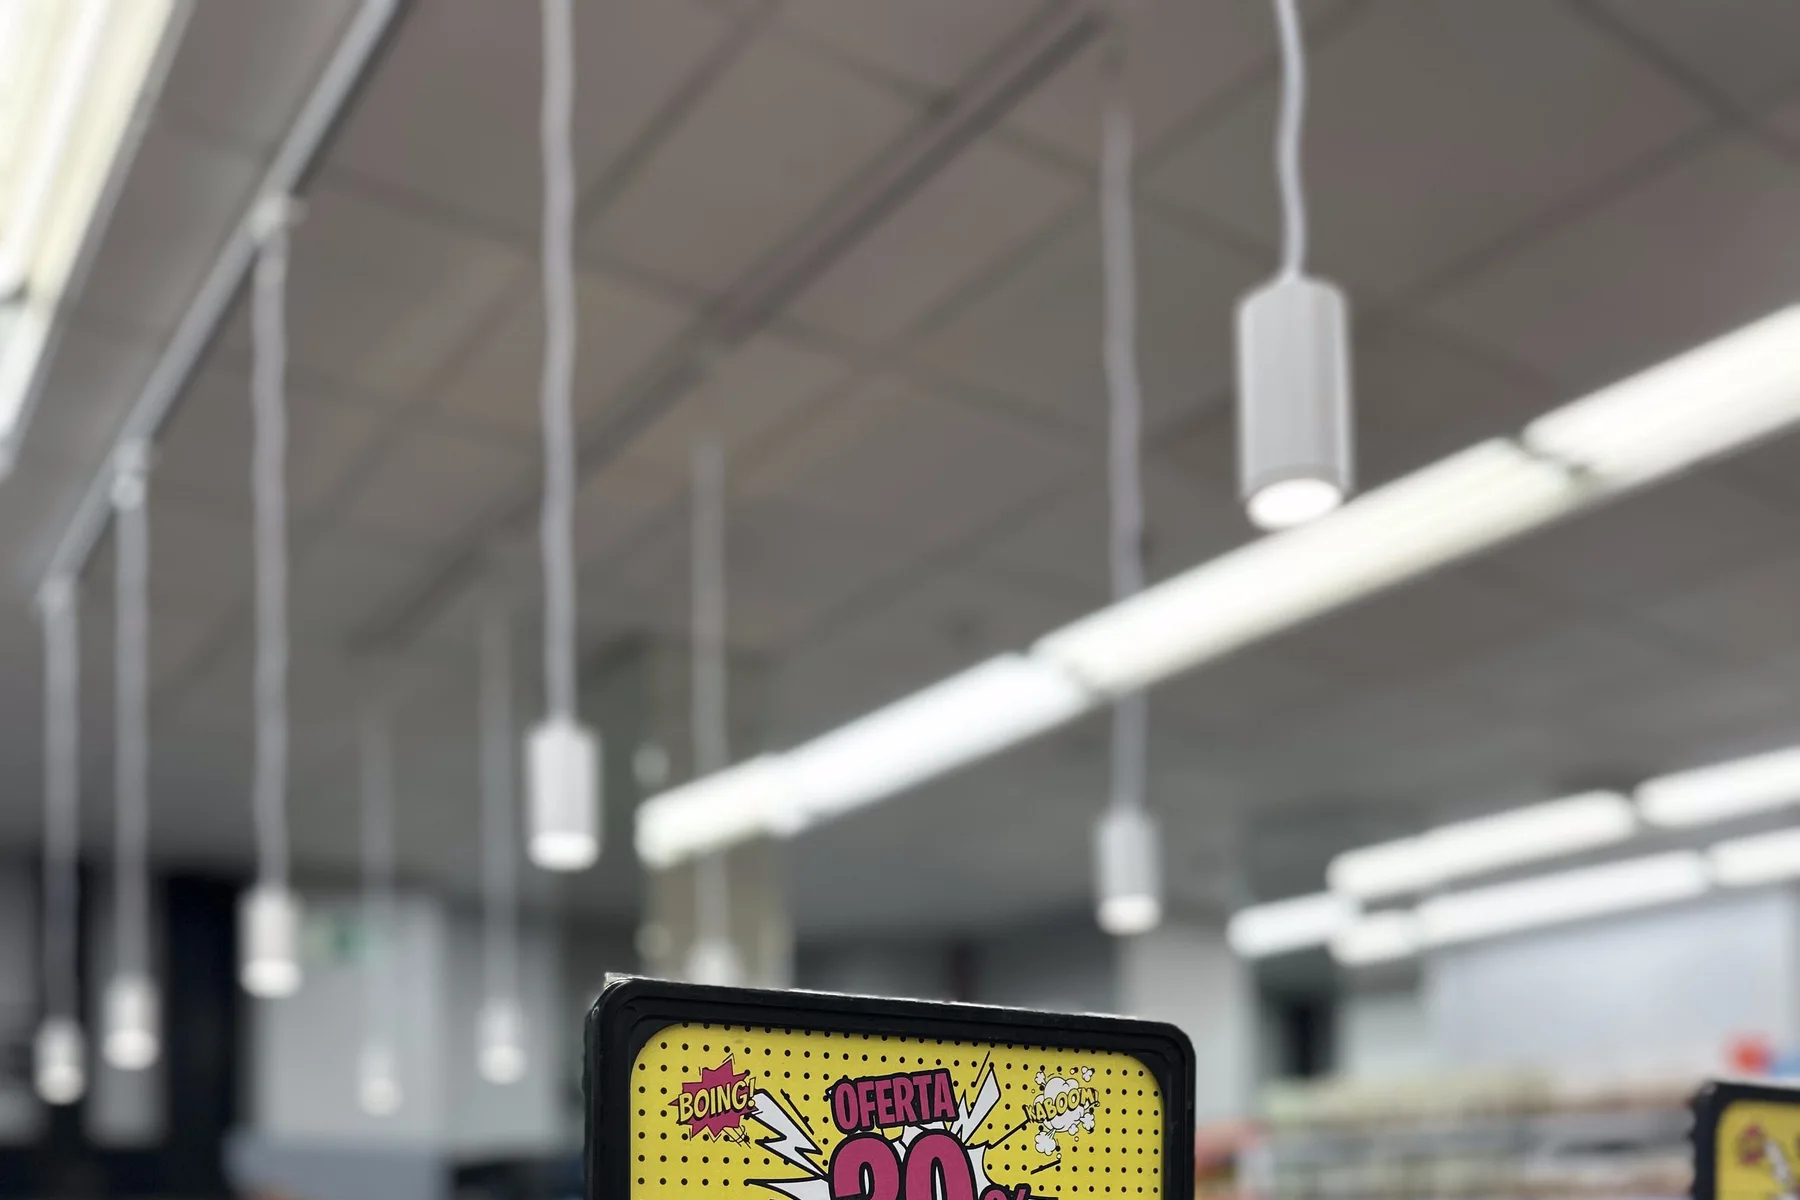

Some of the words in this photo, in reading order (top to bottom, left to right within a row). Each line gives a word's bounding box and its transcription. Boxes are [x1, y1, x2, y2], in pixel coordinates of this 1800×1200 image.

[678, 1077, 756, 1125] BOING!
[831, 1068, 957, 1133] OFERTA
[1023, 1086, 1100, 1123] KABOOM!
